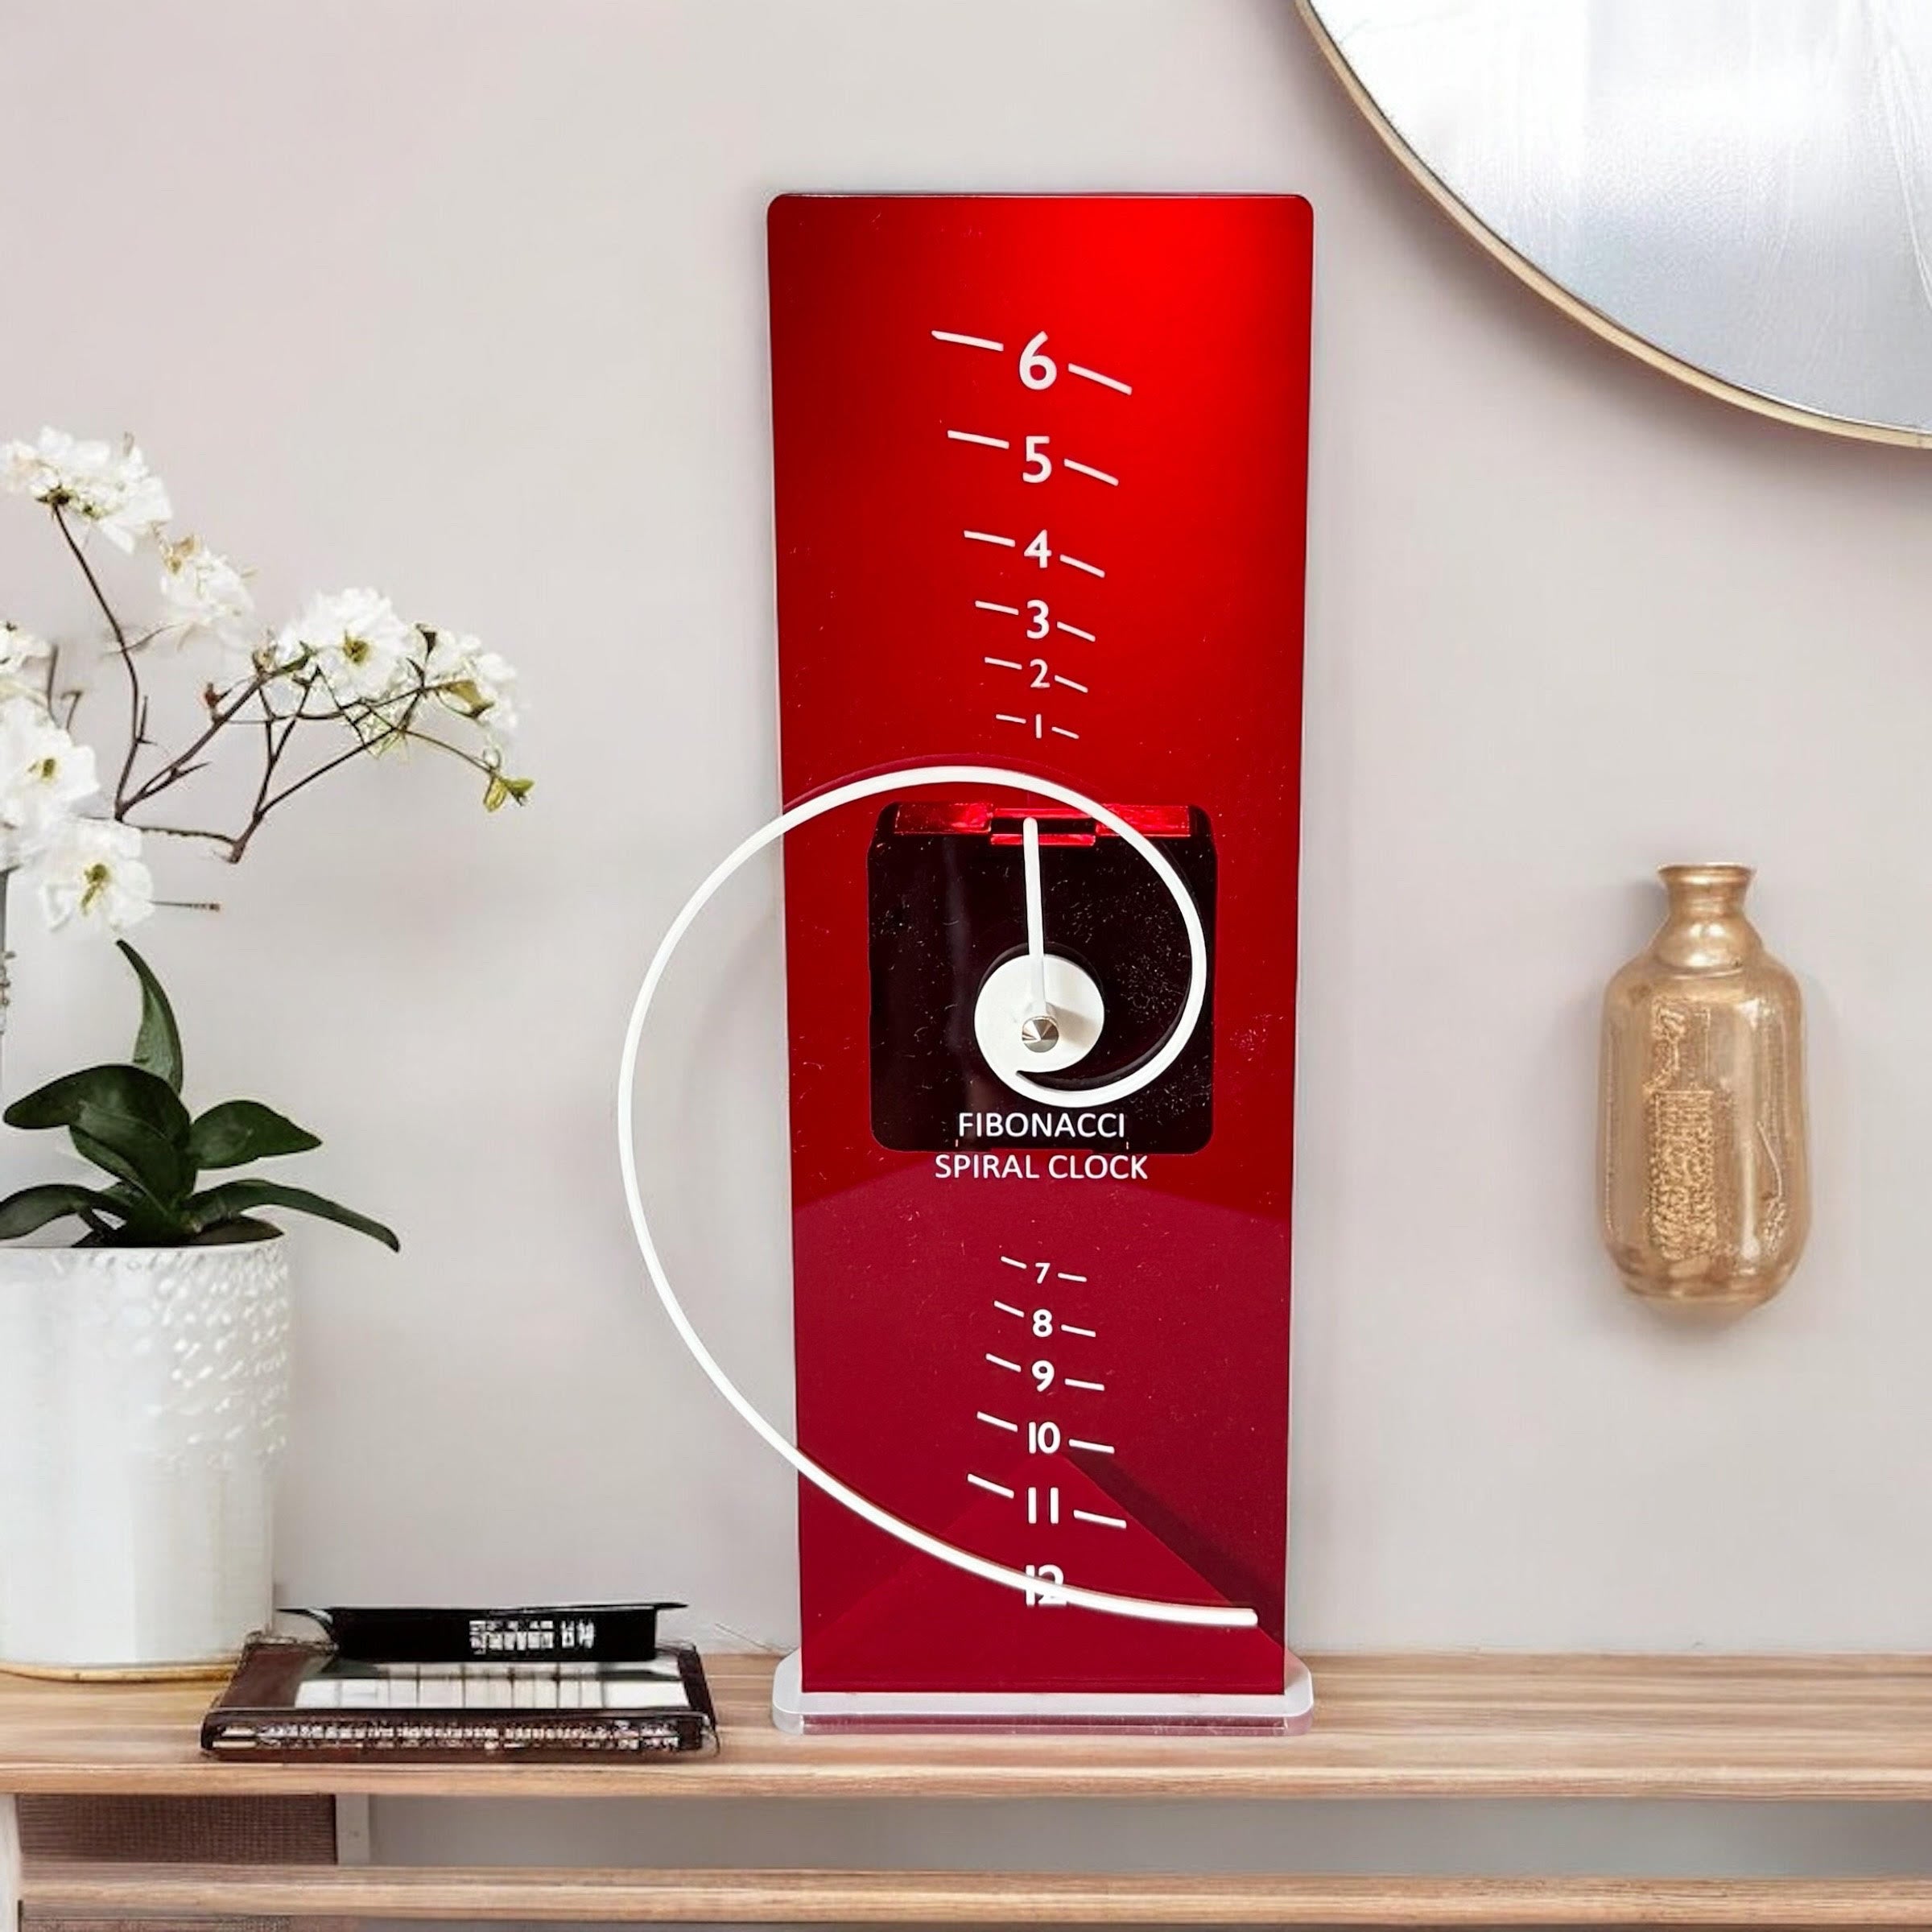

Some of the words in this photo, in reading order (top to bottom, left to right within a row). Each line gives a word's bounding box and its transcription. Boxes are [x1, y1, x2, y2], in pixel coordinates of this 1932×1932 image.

[1019, 331, 1057, 390] 6
[1022, 436, 1052, 483] 5
[1023, 530, 1052, 568] 4
[1026, 599, 1050, 639] 3
[1030, 658, 1051, 688] 2
[1035, 713, 1043, 739] 1
[958, 1112, 1125, 1137] FIBONACCI
[935, 1154, 1040, 1179] SPIRAL
[1048, 1154, 1148, 1180] CLOCK
[1035, 1262, 1051, 1284] 7
[1032, 1308, 1053, 1338] 8
[1031, 1360, 1055, 1392] 9
[1028, 1421, 1061, 1454] 10
[1027, 1487, 1059, 1524] 11
[1026, 1564, 1067, 1606] 12
